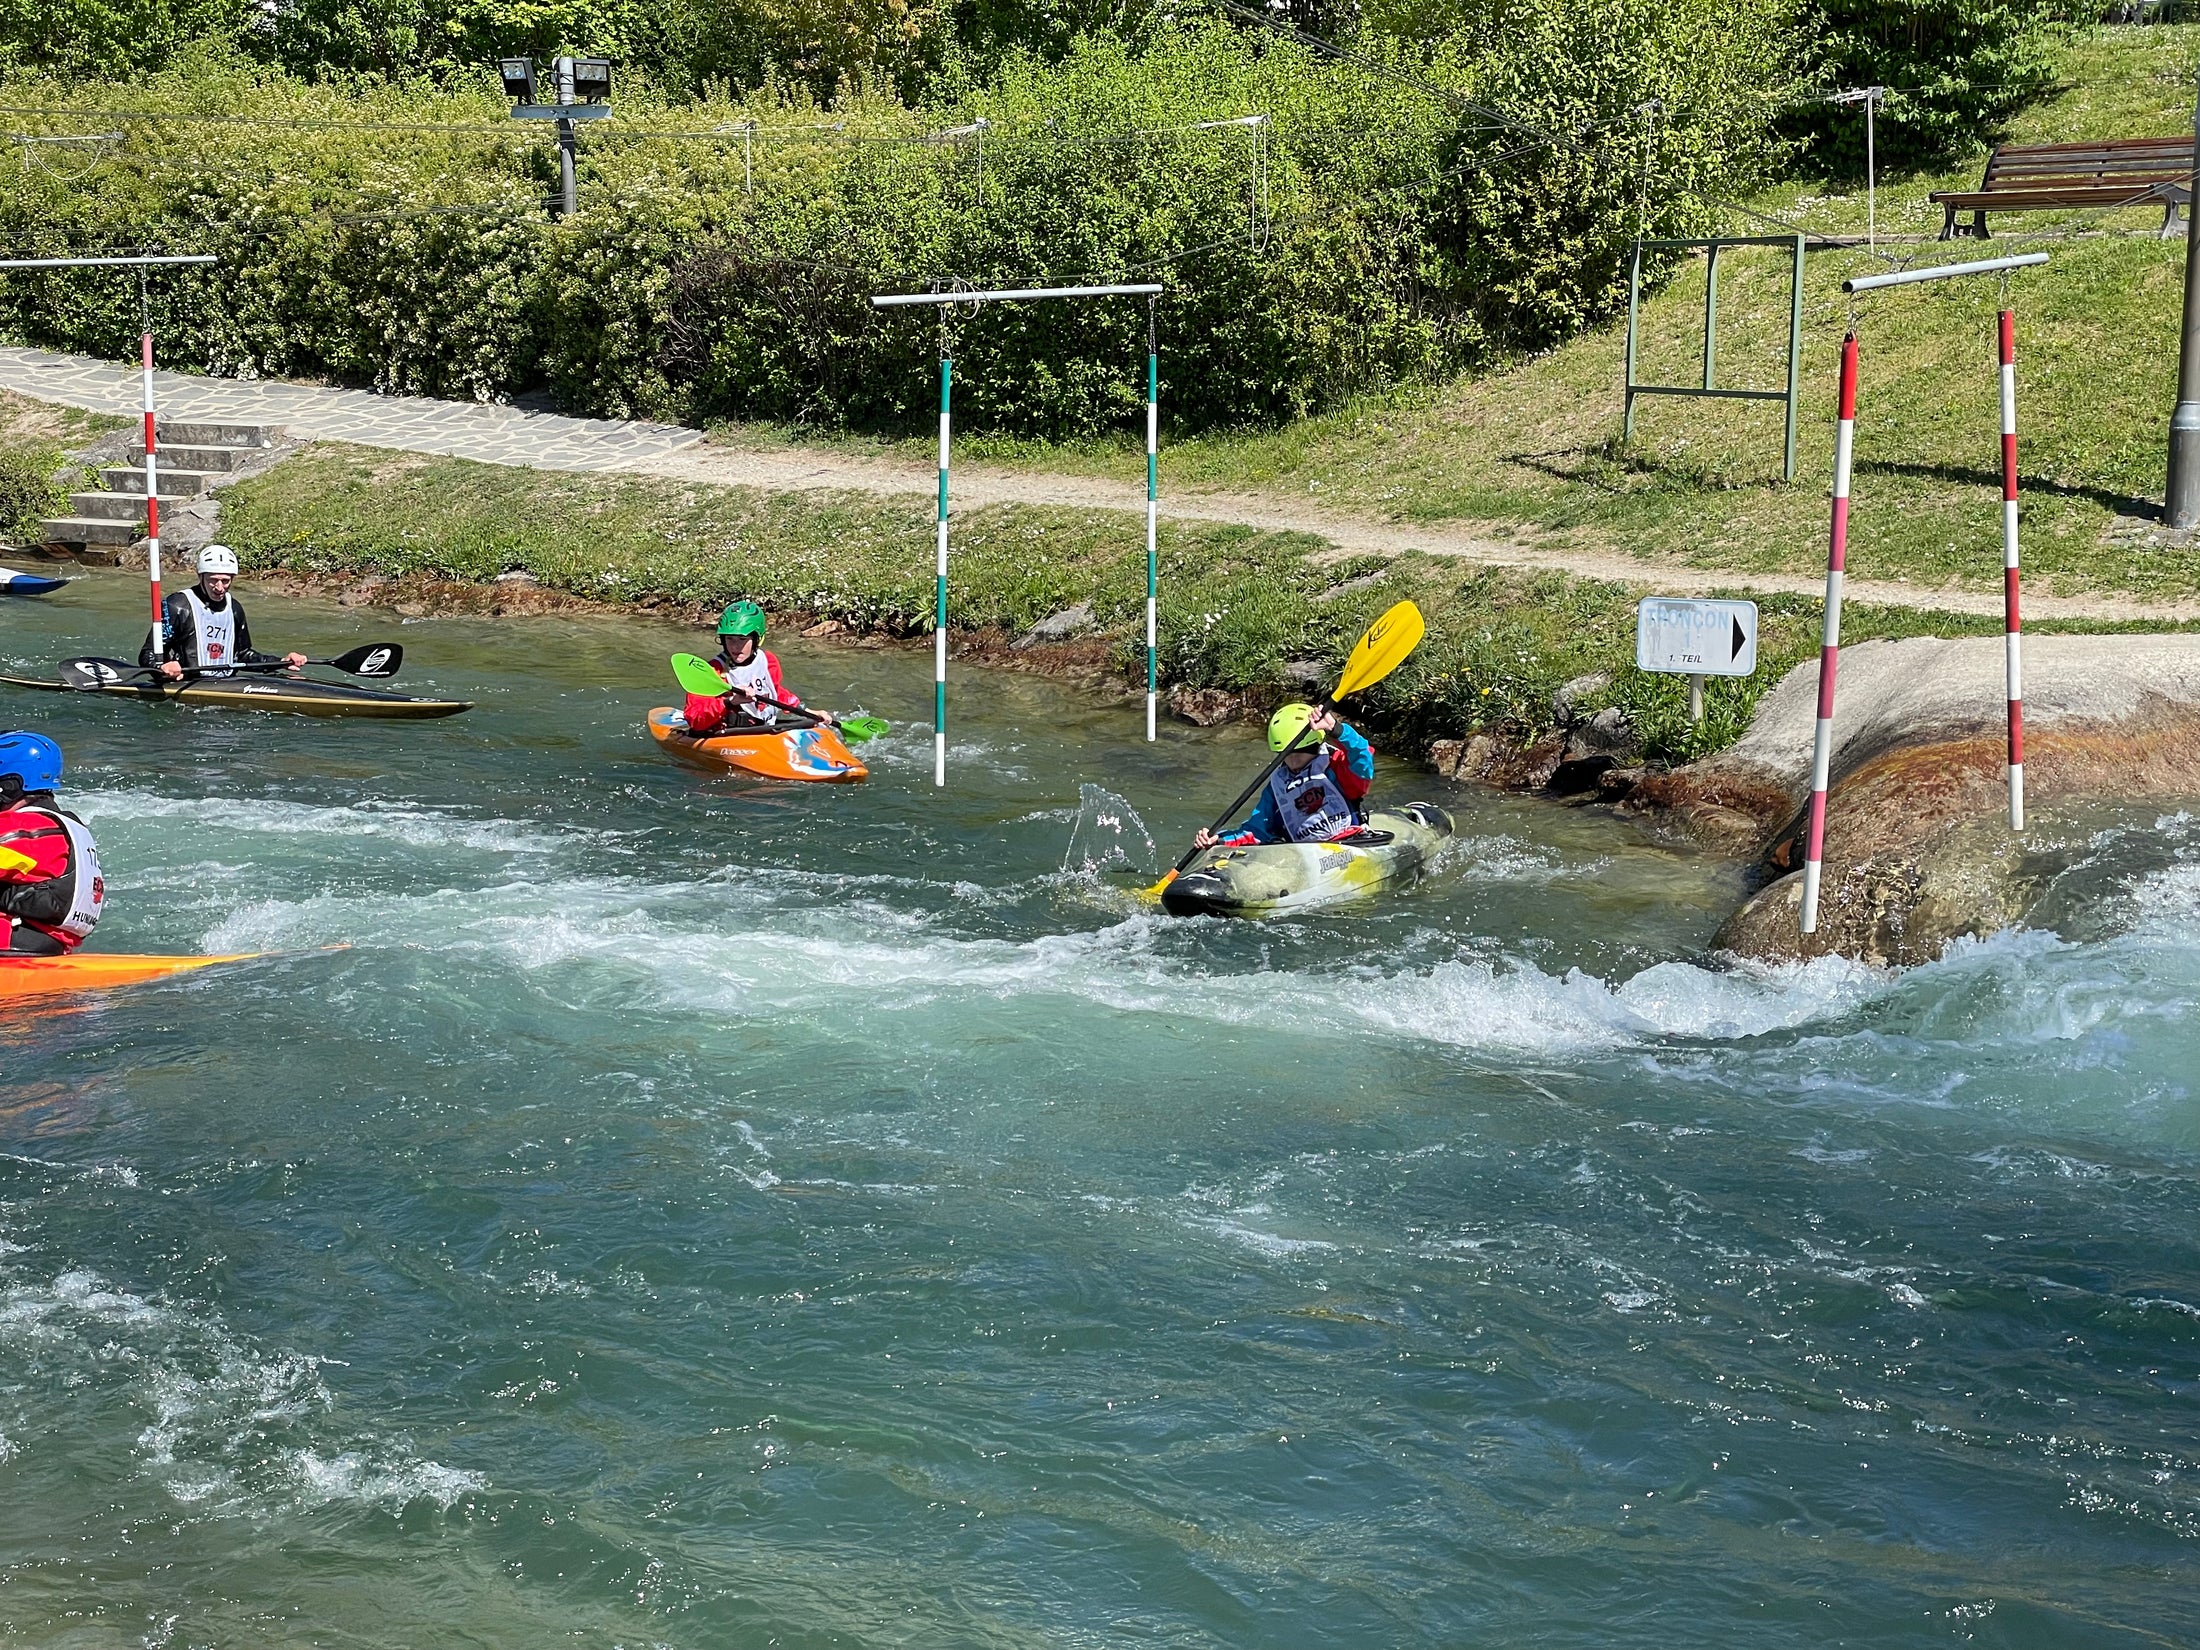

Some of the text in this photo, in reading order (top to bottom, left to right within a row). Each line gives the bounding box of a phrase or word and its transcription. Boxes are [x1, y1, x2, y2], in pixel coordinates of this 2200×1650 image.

[206, 625, 227, 640] 271
[1681, 654, 1703, 663] TEIL
[1294, 786, 1326, 810] ECN
[1296, 811, 1347, 840] HUNINGUE
